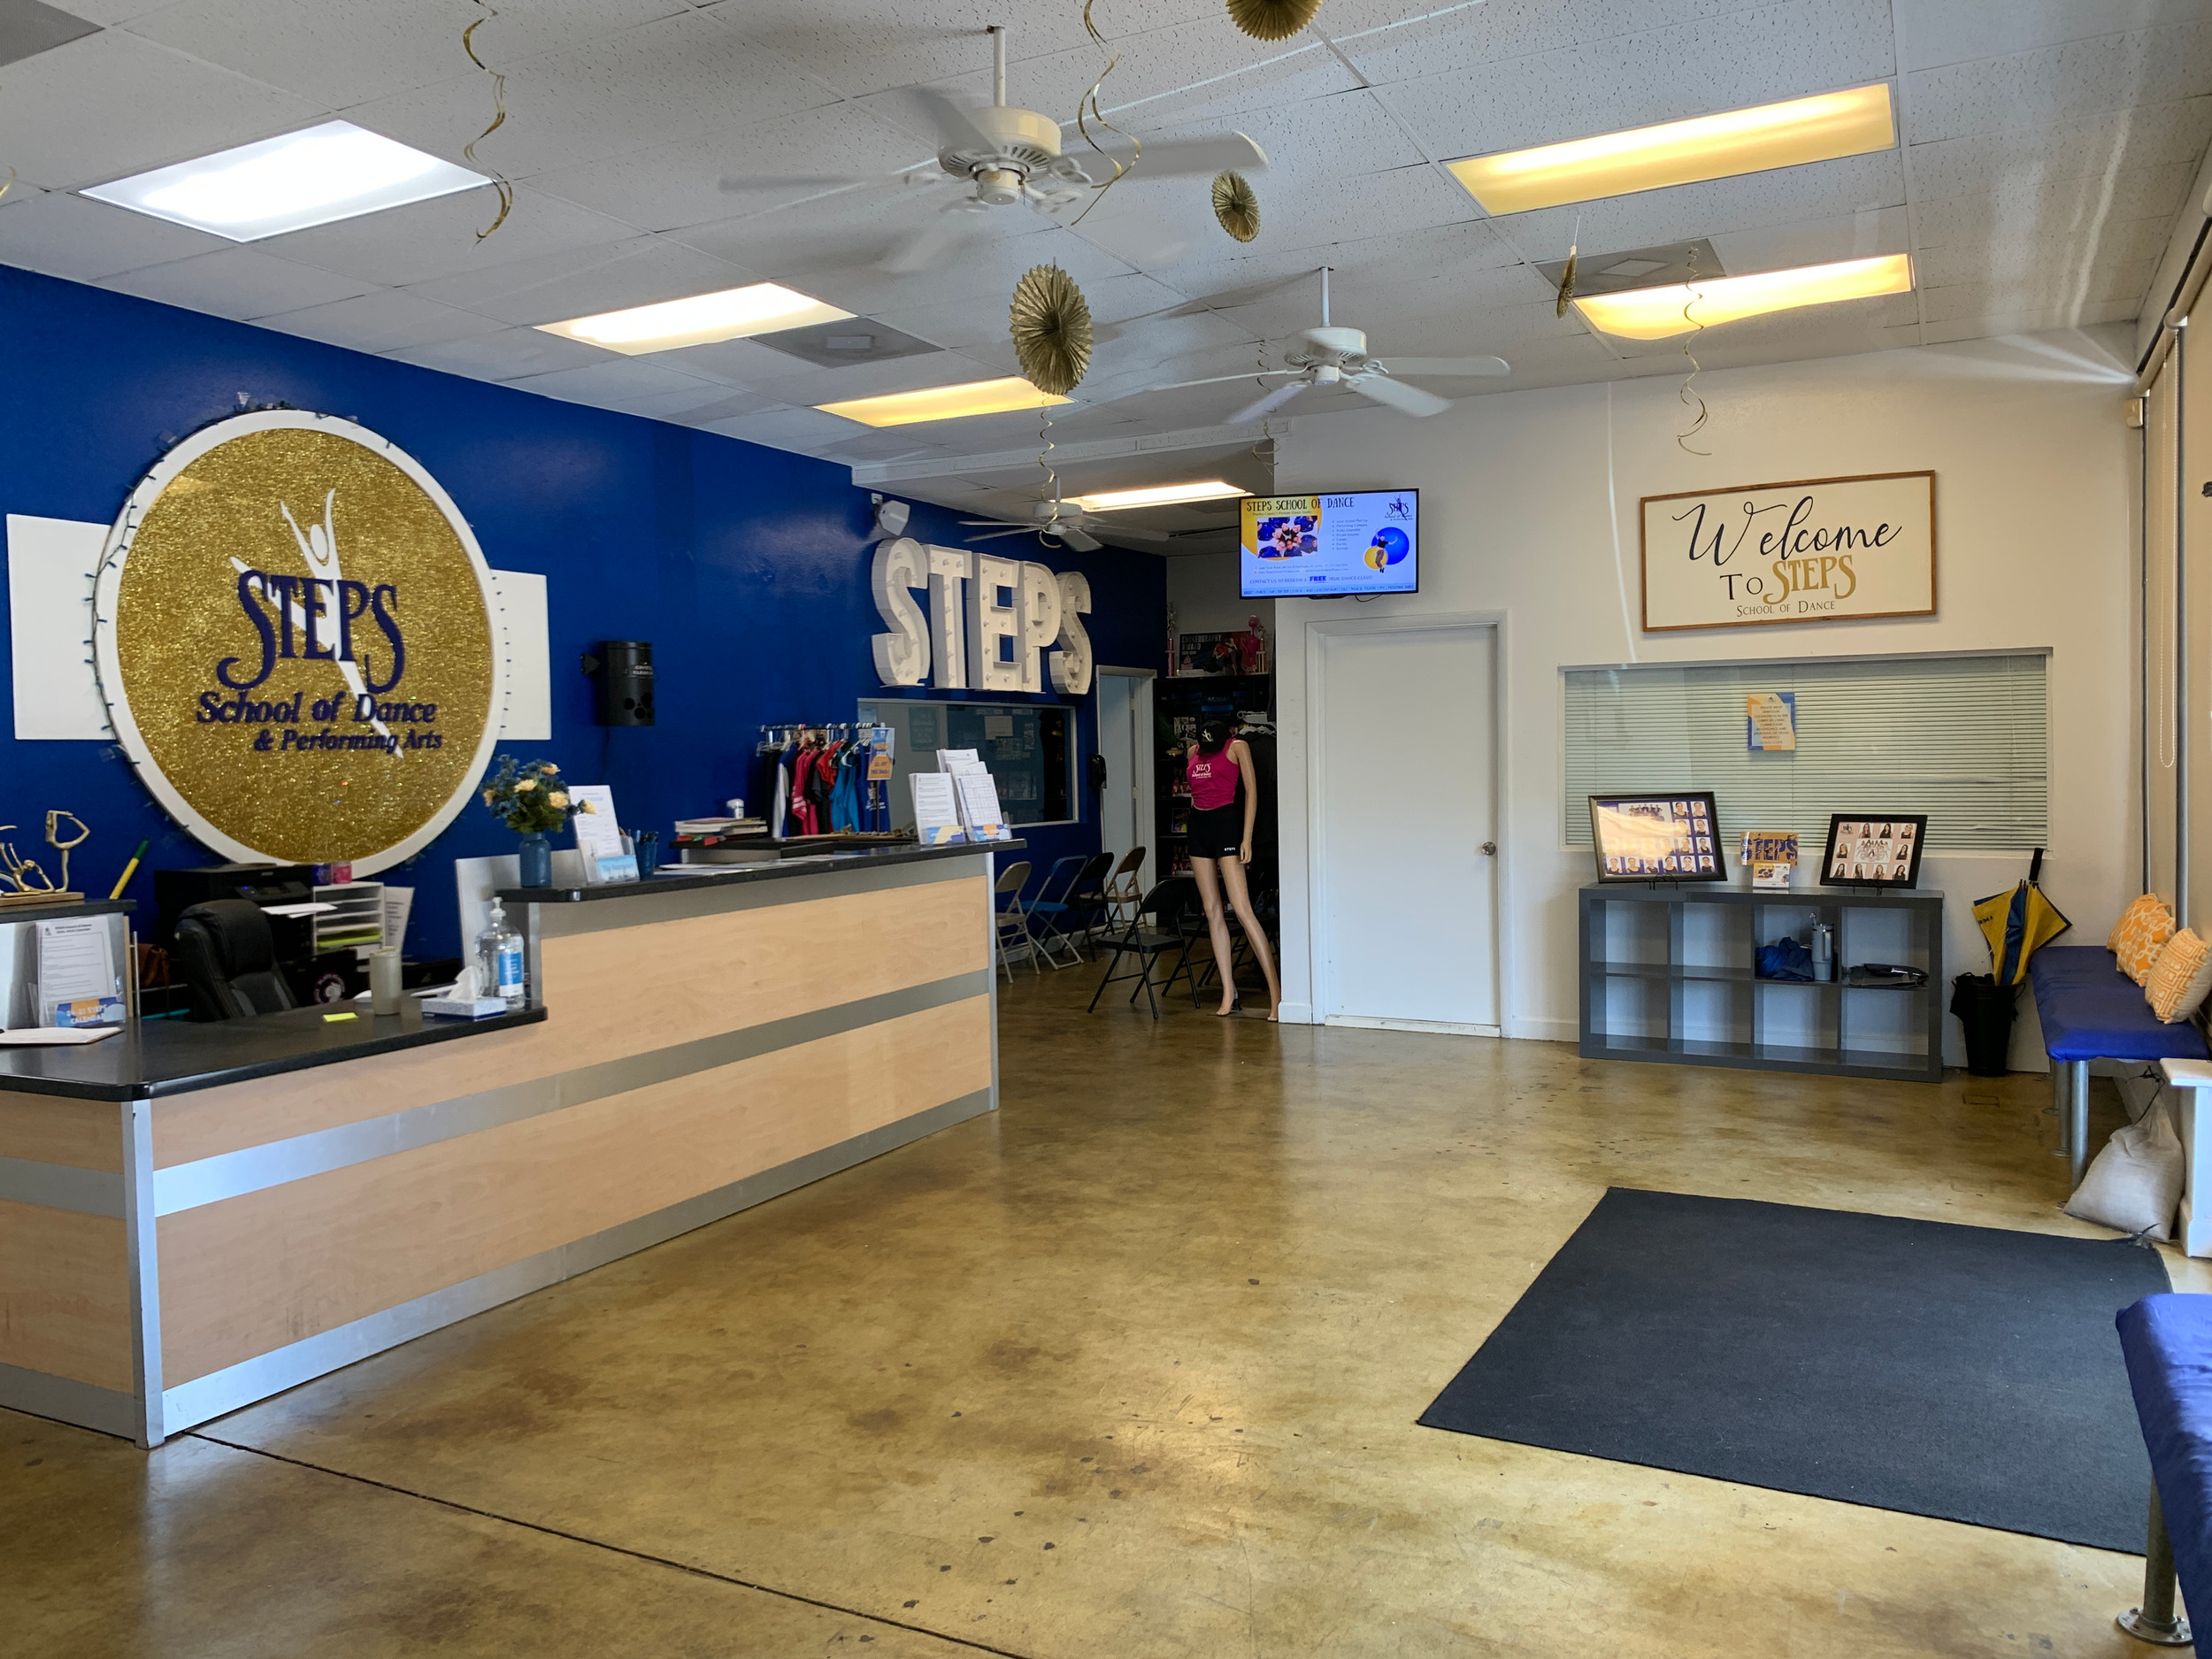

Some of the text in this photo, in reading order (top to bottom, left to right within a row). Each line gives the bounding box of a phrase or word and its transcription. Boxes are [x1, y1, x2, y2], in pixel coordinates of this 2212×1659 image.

[1247, 497, 1355, 512] STEPS SCHOOL OF DANCE
[1672, 495, 1902, 566] Welcome
[1763, 554, 1856, 604] STEPS
[217, 569, 405, 694] STEPS
[872, 537, 1092, 695] STEPS
[196, 691, 438, 724] School of Dance
[254, 728, 442, 754] & Performing Arts
[1741, 839, 1797, 860] STEPS
